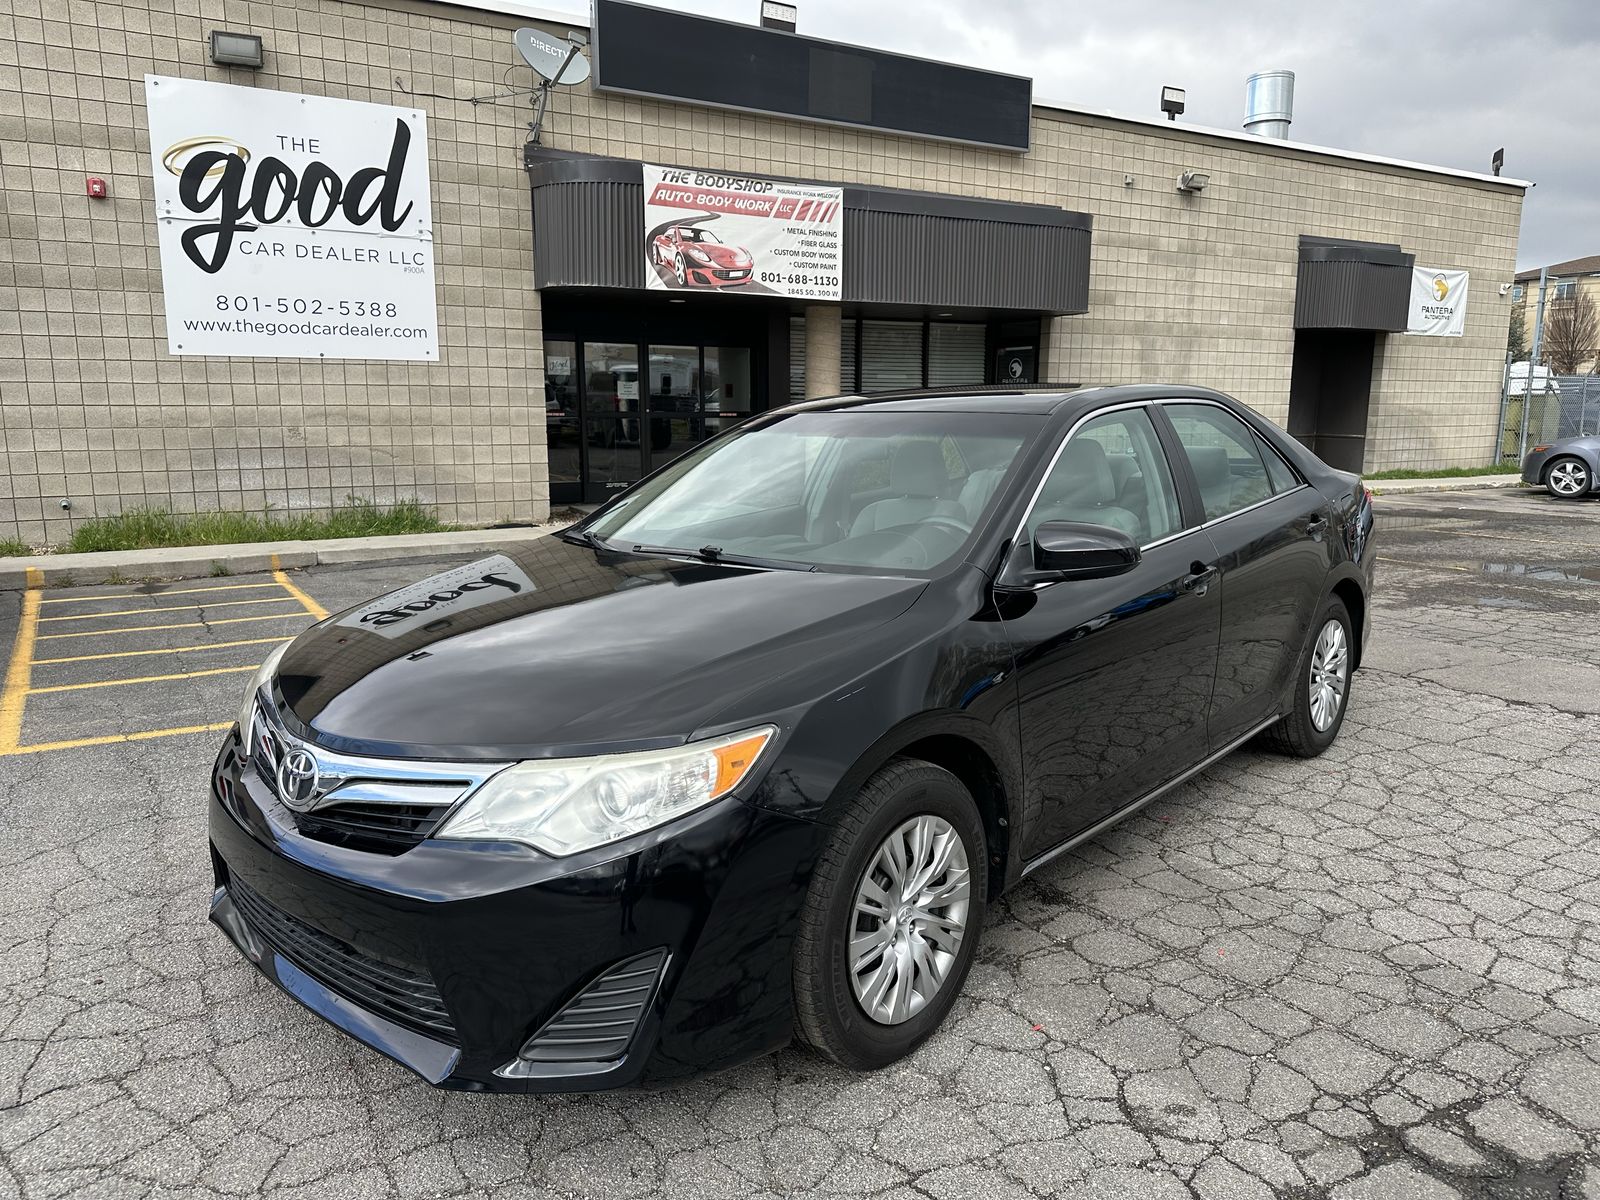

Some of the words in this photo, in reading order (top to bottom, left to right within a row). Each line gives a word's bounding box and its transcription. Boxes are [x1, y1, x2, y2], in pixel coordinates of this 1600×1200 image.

[276, 135, 321, 154] THE
[662, 169, 690, 184] THE
[695, 170, 773, 194] BODYSHOP
[179, 118, 413, 274] good
[656, 189, 693, 203] AUTO
[697, 194, 732, 208] BODY
[735, 198, 773, 212] WORK
[780, 204, 792, 213] LLC
[787, 227, 807, 236] METAL
[809, 229, 837, 238] FINISHING
[239, 241, 286, 257] CAR
[296, 244, 379, 264] DEALER
[389, 250, 424, 266] LLC
[801, 239, 818, 247] FIBER
[819, 241, 837, 249] GLASS
[774, 248, 800, 257] CUSTOM
[818, 252, 837, 260] WORK
[793, 261, 818, 269] CUSTOM
[761, 272, 839, 287] 801-688-1130
[215, 295, 397, 318] 801-502-5388
[1421, 306, 1454, 315] PANTERA
[184, 319, 428, 339] www.thegoodcardealer.com
